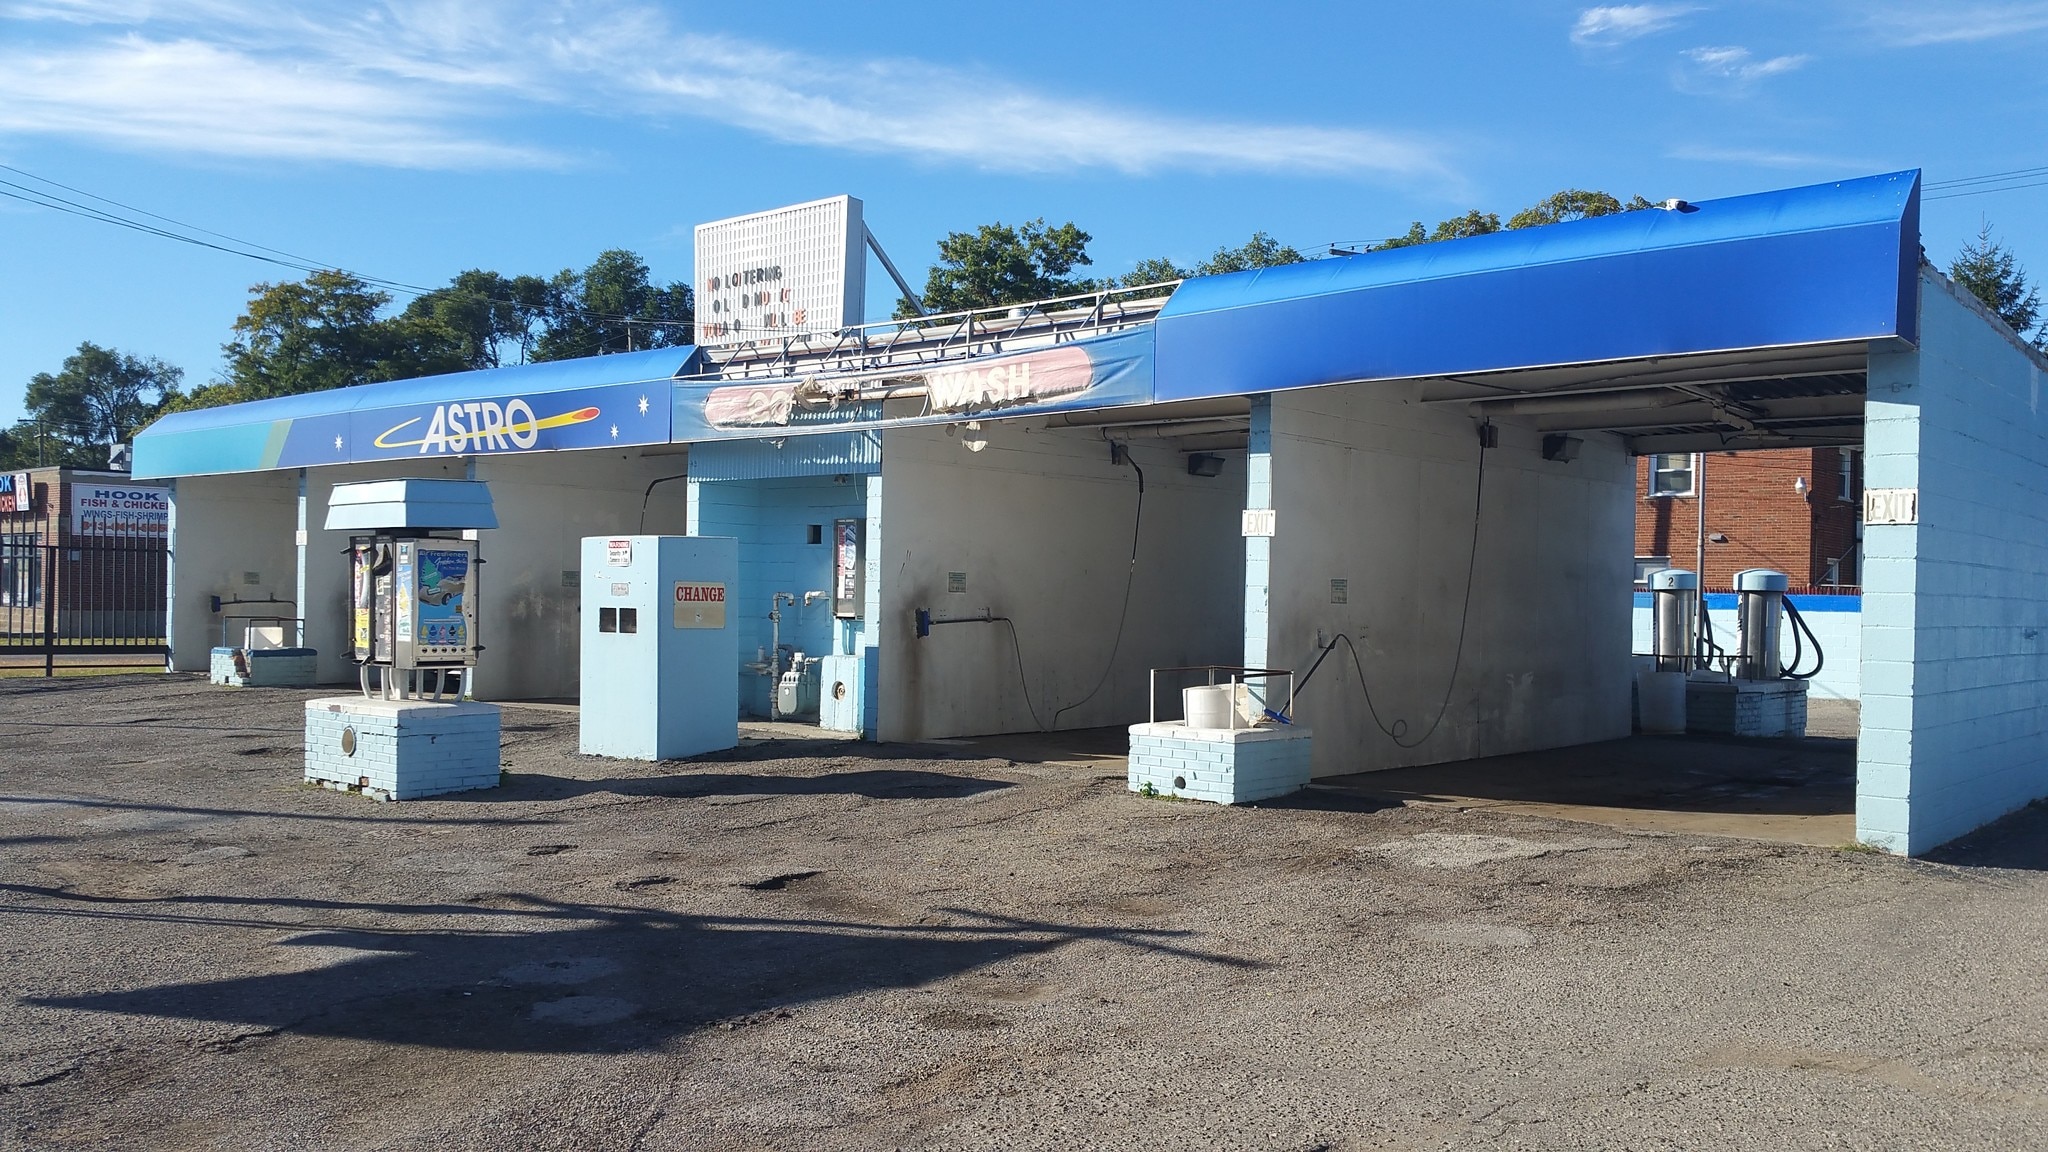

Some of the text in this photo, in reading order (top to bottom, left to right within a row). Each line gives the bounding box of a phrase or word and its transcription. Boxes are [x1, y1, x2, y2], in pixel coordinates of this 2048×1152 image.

[707, 265, 782, 293] NO LOITERING
[793, 309, 806, 325] BE
[930, 362, 1030, 409] WASH
[419, 398, 538, 454] ASTRO
[80, 498, 107, 508] FISH
[111, 500, 119, 508] &
[95, 490, 160, 501] HOOK
[1871, 493, 1910, 520] EXIT
[1246, 513, 1270, 533] EXIT
[1668, 576, 1674, 587] 2
[675, 586, 725, 602] CHANGE
